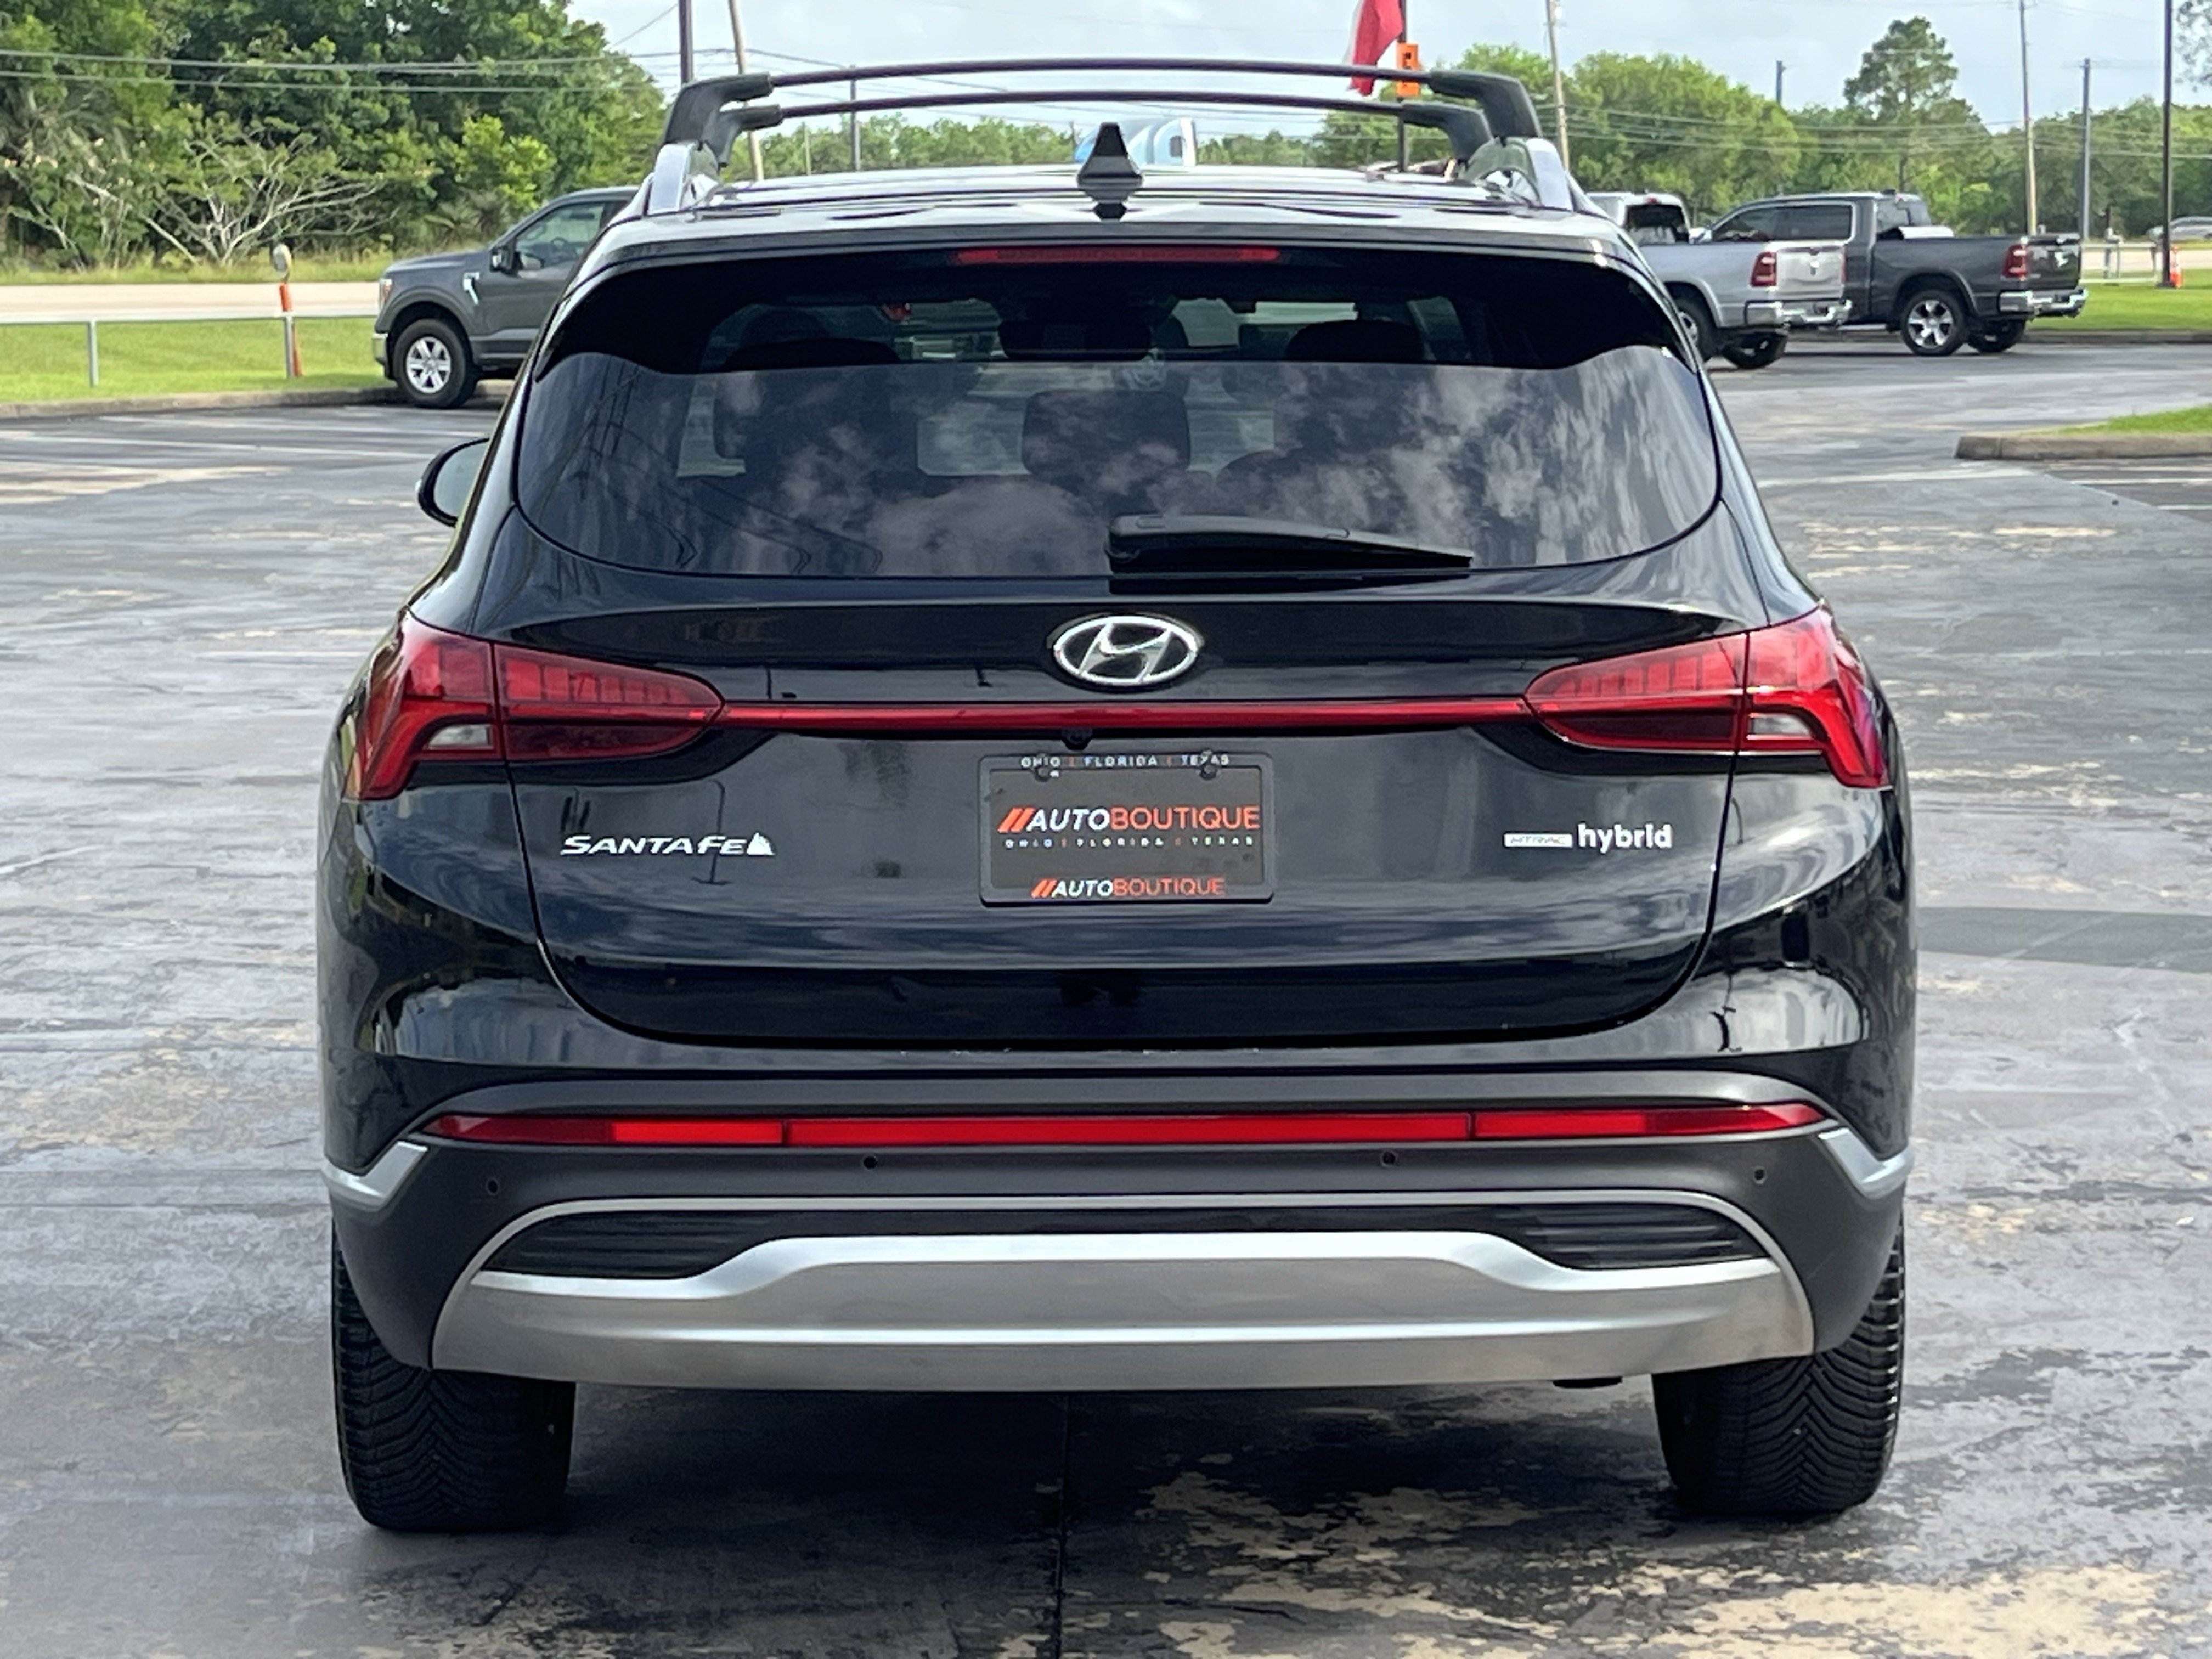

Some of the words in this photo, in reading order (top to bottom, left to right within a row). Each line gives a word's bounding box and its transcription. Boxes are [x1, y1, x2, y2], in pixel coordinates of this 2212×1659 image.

[1020, 756, 1061, 768] OHIO
[1084, 755, 1158, 768] FLORIDA
[1181, 754, 1229, 766] TEXAS
[1578, 823, 1672, 853] hybrid
